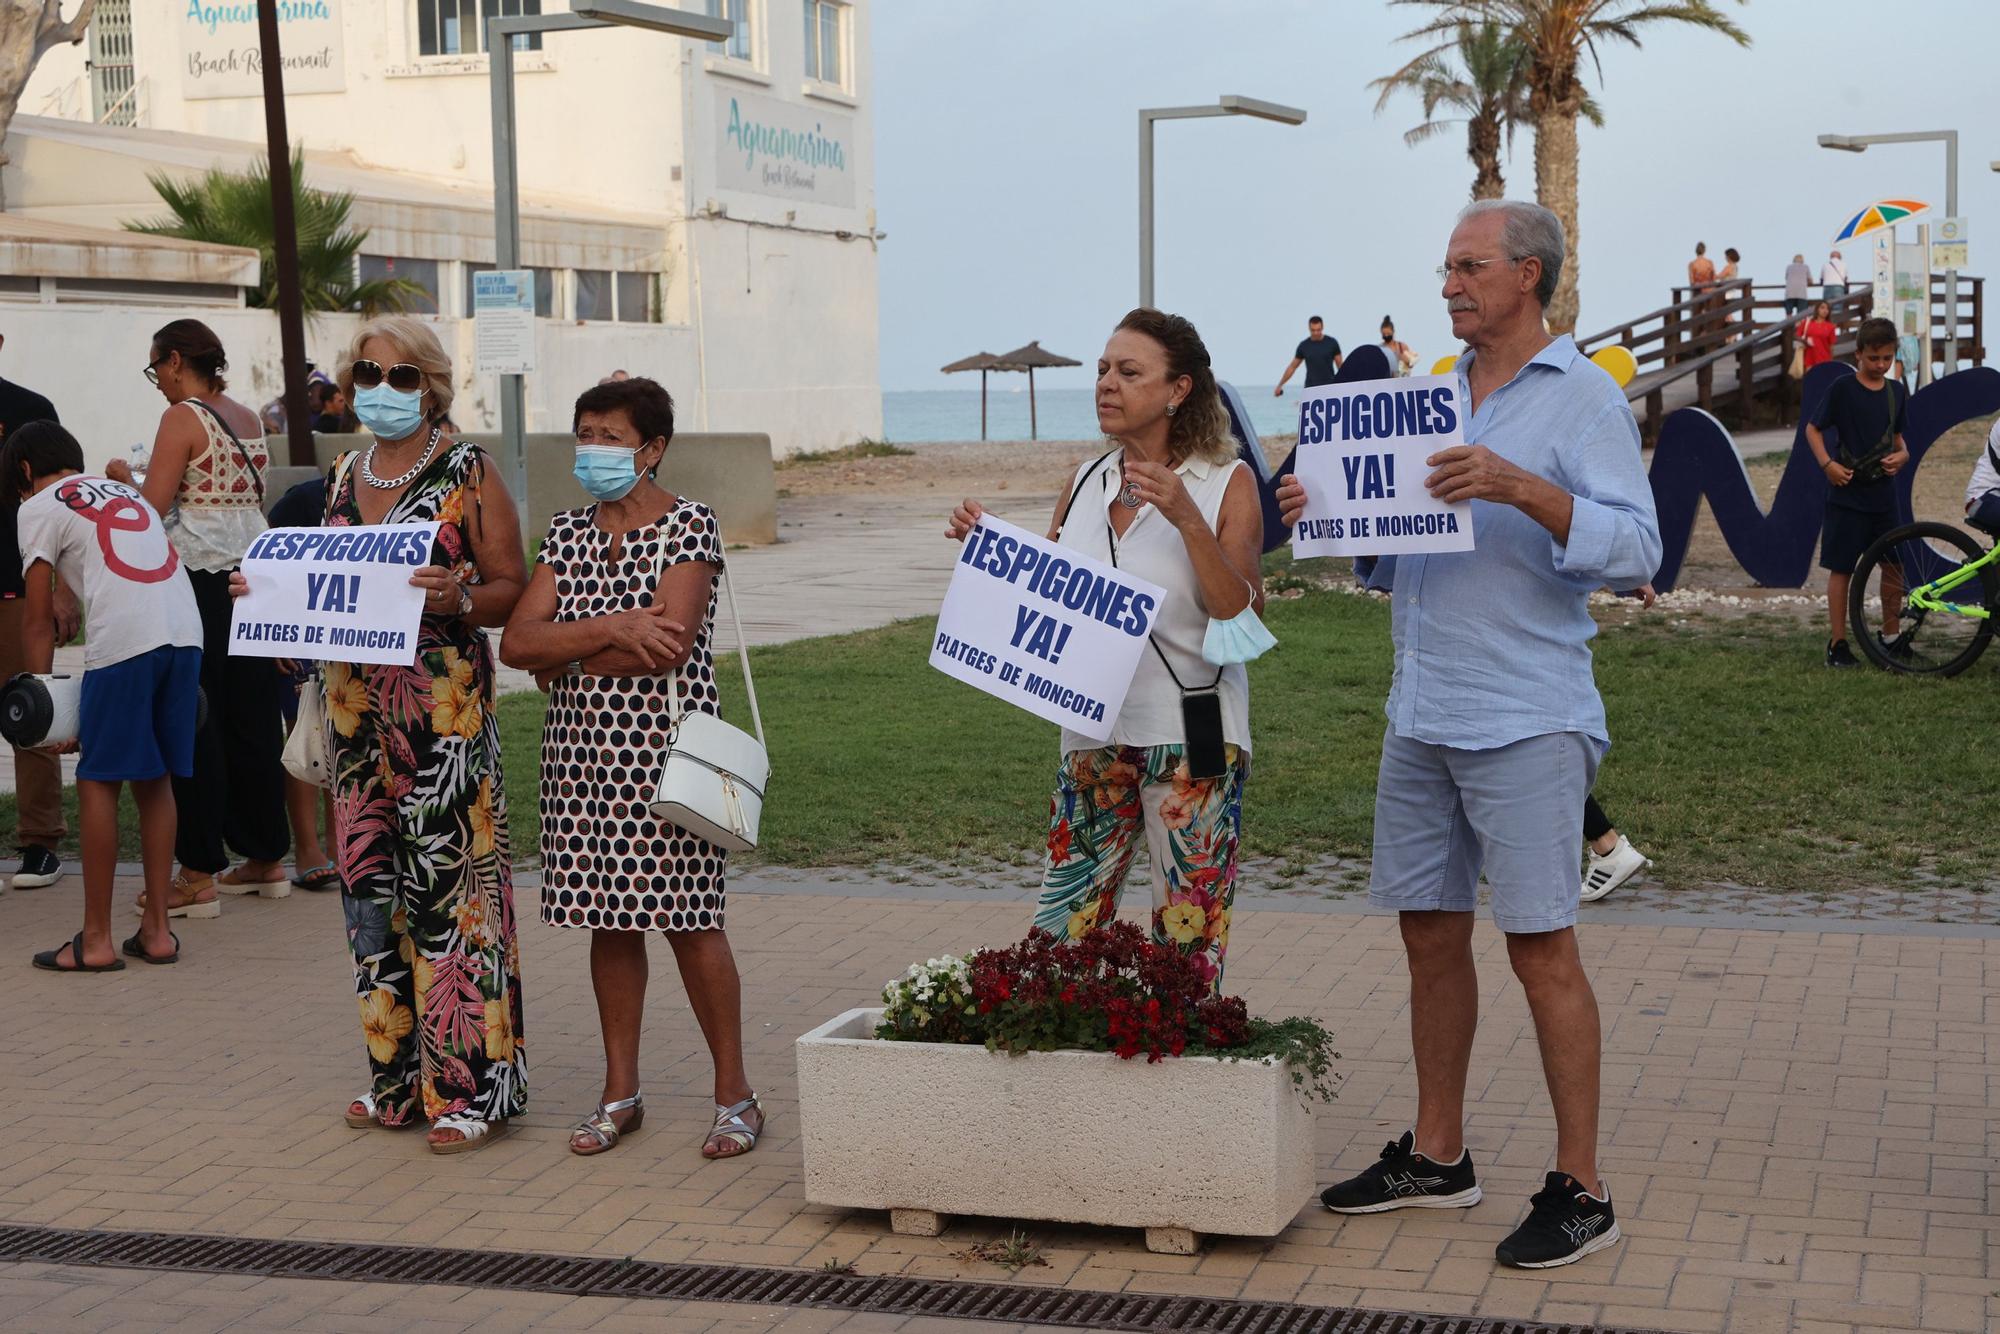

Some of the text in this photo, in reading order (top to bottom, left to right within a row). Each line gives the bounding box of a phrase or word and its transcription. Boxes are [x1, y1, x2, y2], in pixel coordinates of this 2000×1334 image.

[188, 49, 239, 78] Beach
[727, 98, 845, 172] Aguamarina
[1298, 387, 1457, 445] ESPIGONES
[1341, 453, 1396, 500] YA!
[248, 530, 431, 566] ¡ESPIGONES
[1298, 512, 1459, 541] PLATGES DE MONCOFA
[306, 573, 361, 614] YA!
[960, 524, 1155, 638] ¡ESPIGONES
[236, 622, 406, 650] PLATGES DE MONCOFA
[1009, 603, 1073, 665] YA!
[935, 632, 1106, 723] PLATGES DE MONCOFA
